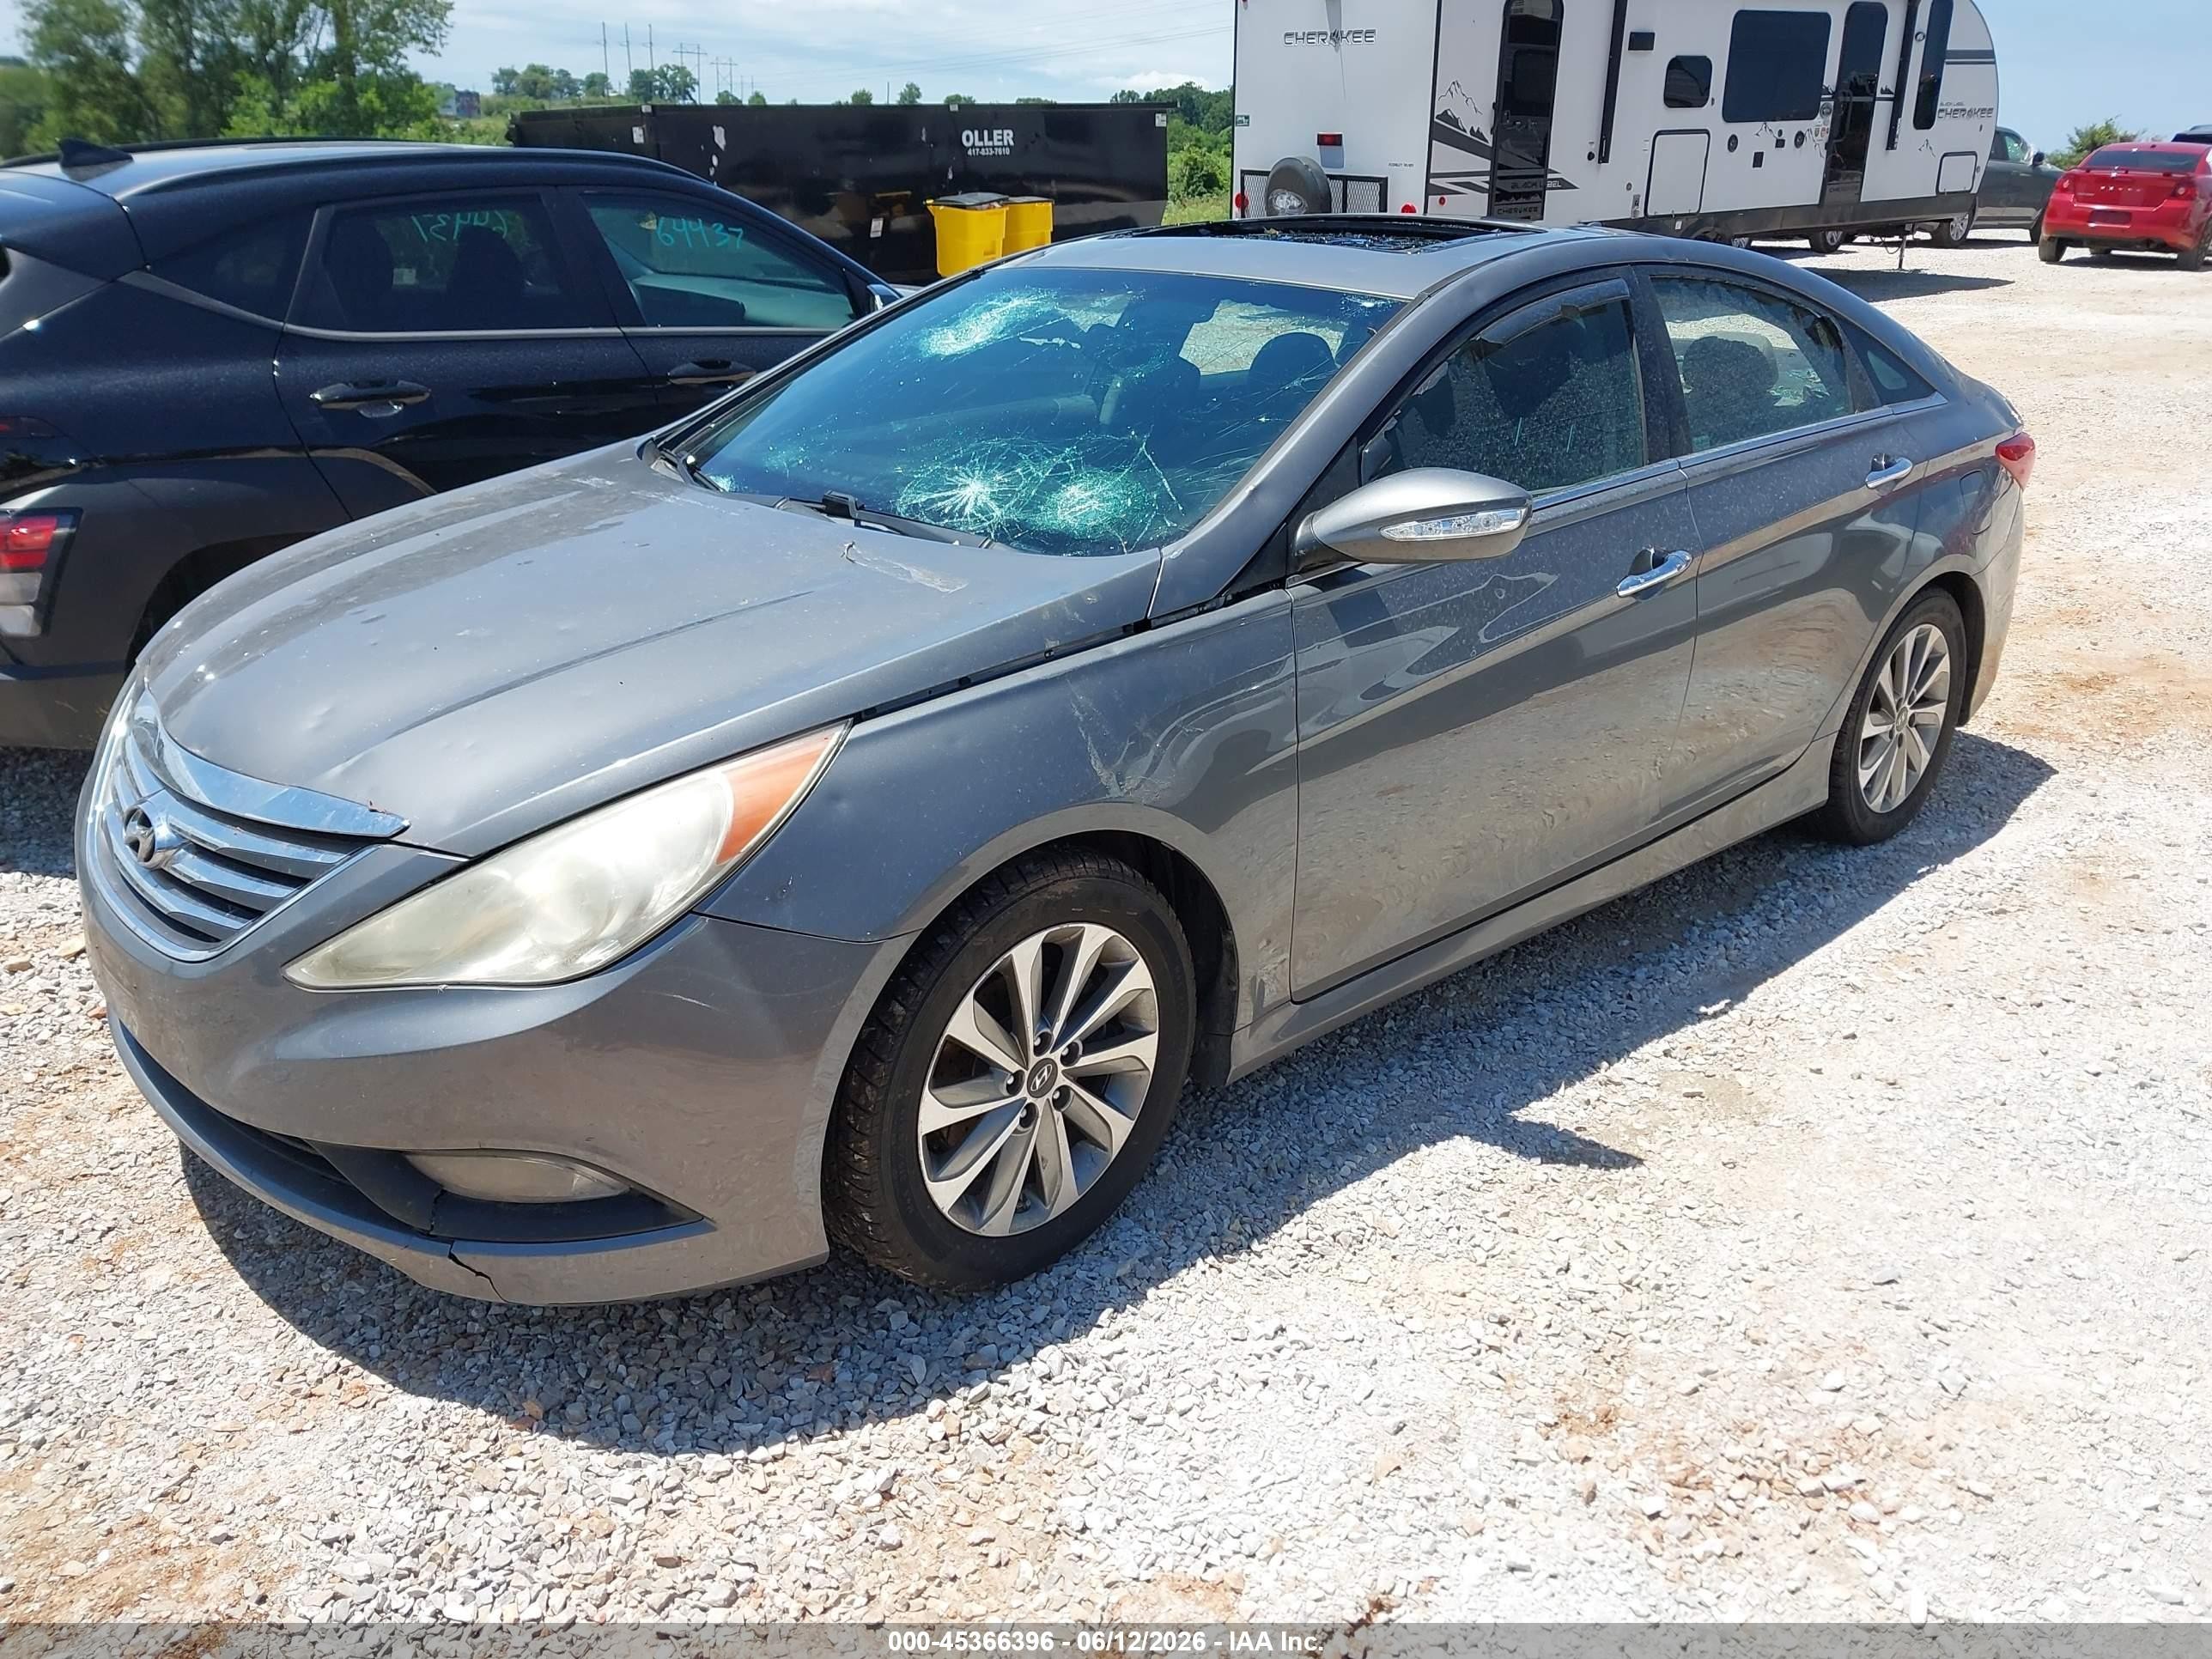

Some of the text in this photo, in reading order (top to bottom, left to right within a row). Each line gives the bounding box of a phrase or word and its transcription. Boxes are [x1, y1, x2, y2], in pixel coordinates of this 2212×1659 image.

[962, 129, 1014, 147] OLLER
[967, 147, 1011, 155] 417-833-7610
[656, 216, 744, 248] 64437
